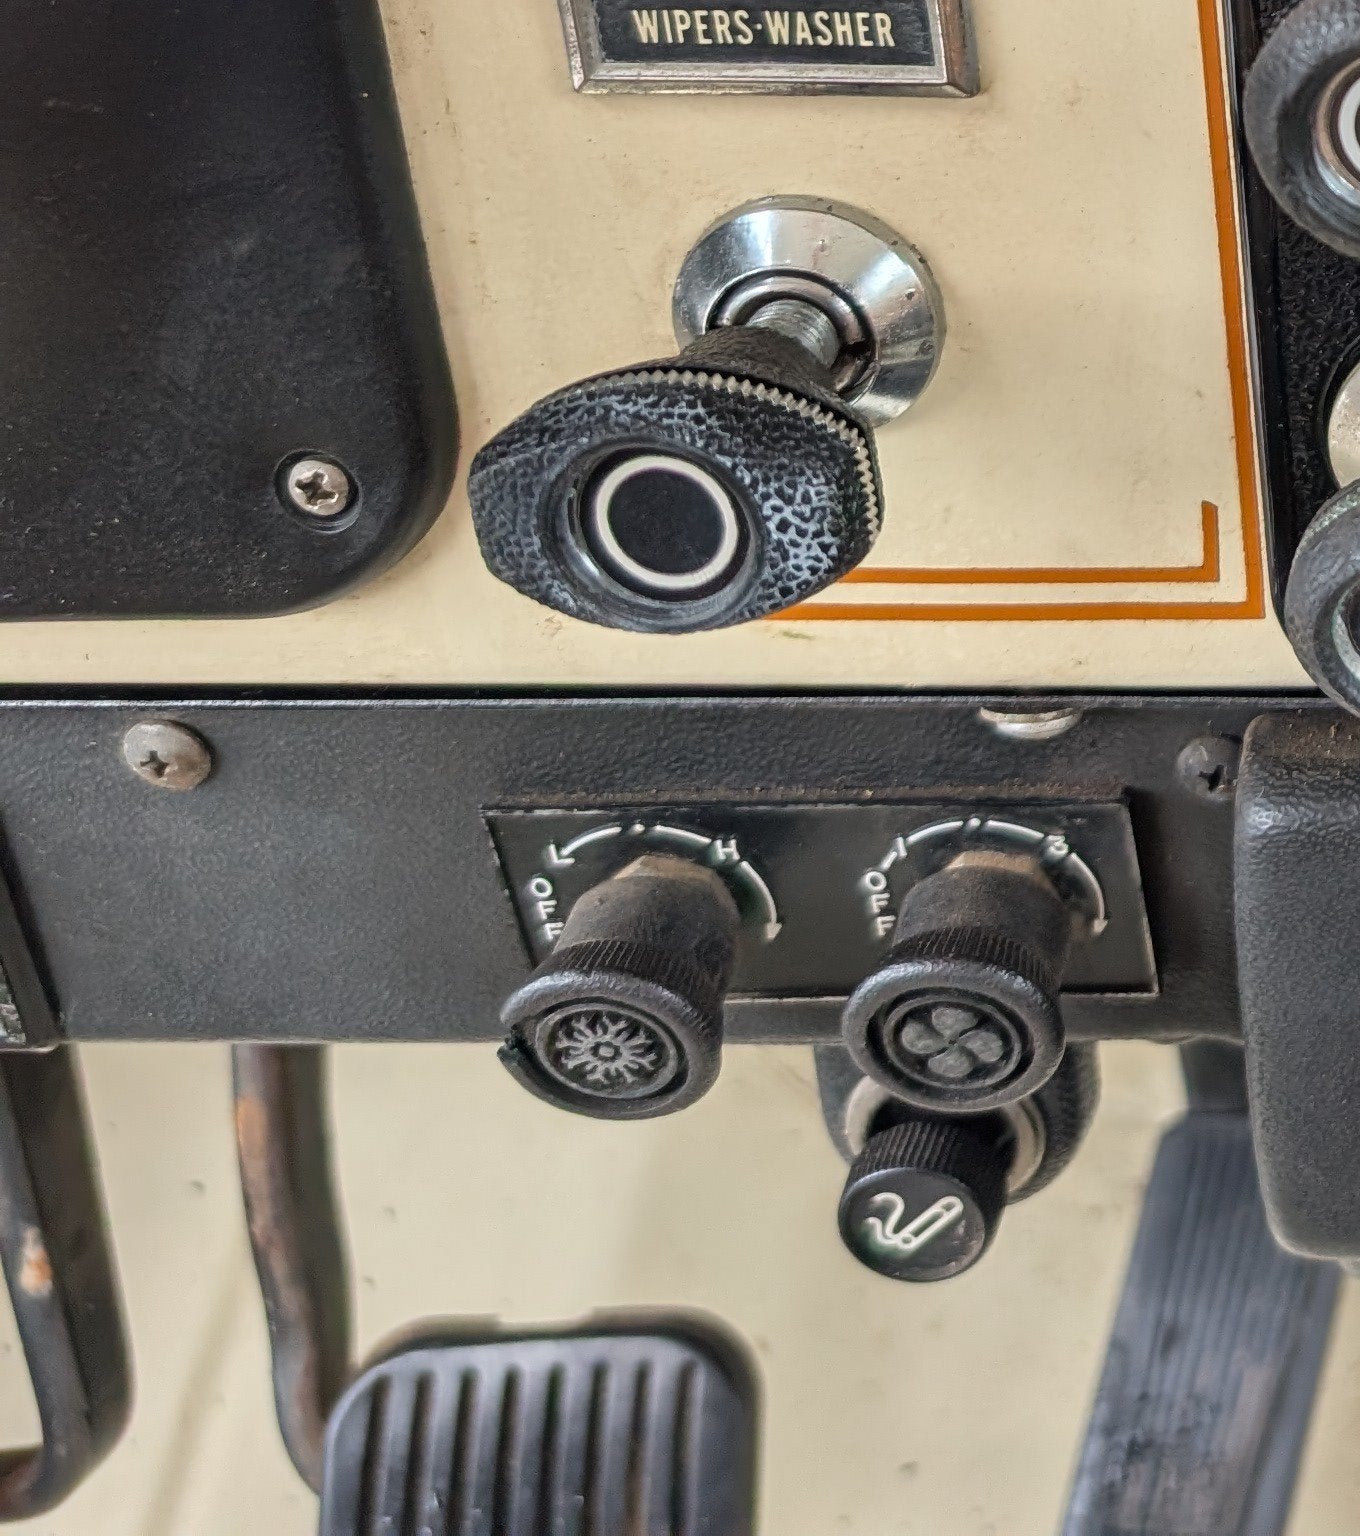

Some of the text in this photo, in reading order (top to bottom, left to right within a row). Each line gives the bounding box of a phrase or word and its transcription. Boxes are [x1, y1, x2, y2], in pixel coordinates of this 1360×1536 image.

[715, 838, 741, 860] H
[1046, 834, 1069, 856] 3
[530, 877, 565, 940] OFF
[865, 870, 896, 936] OFF
